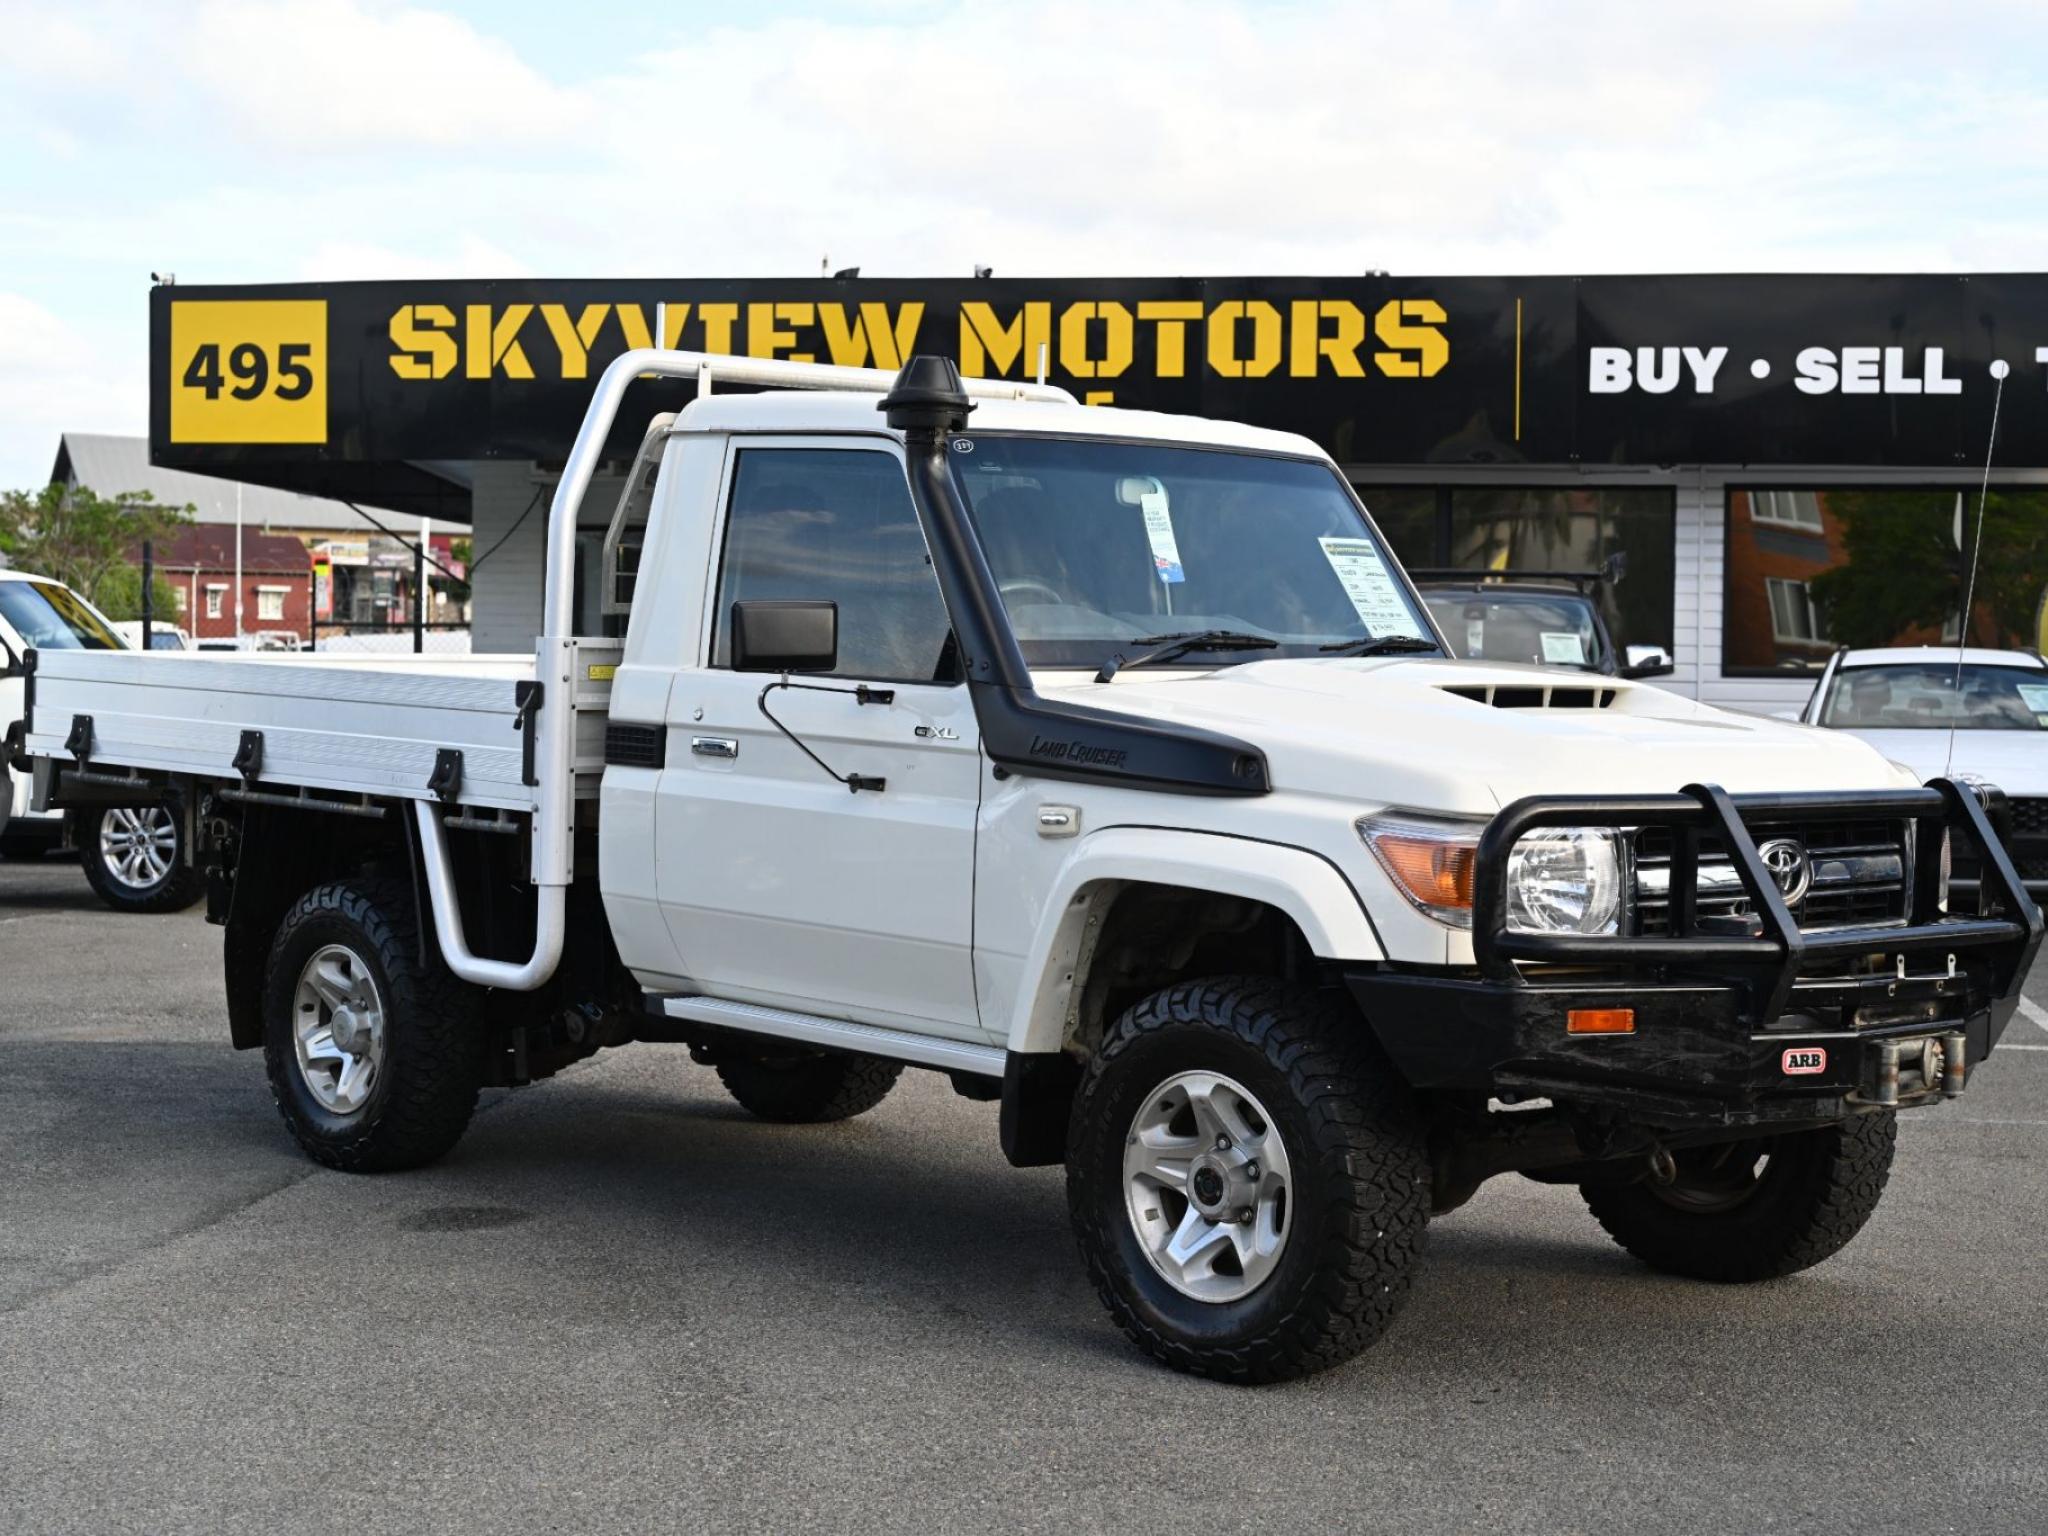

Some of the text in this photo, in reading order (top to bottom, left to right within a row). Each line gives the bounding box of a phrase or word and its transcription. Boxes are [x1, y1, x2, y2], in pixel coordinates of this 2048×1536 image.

[389, 299, 1451, 381] SKYVIEW MOTORS
[183, 343, 313, 401] 495
[1589, 346, 1963, 395] BUY SELL
[914, 726, 960, 740] GXL
[1788, 1054, 1821, 1068] ARB
